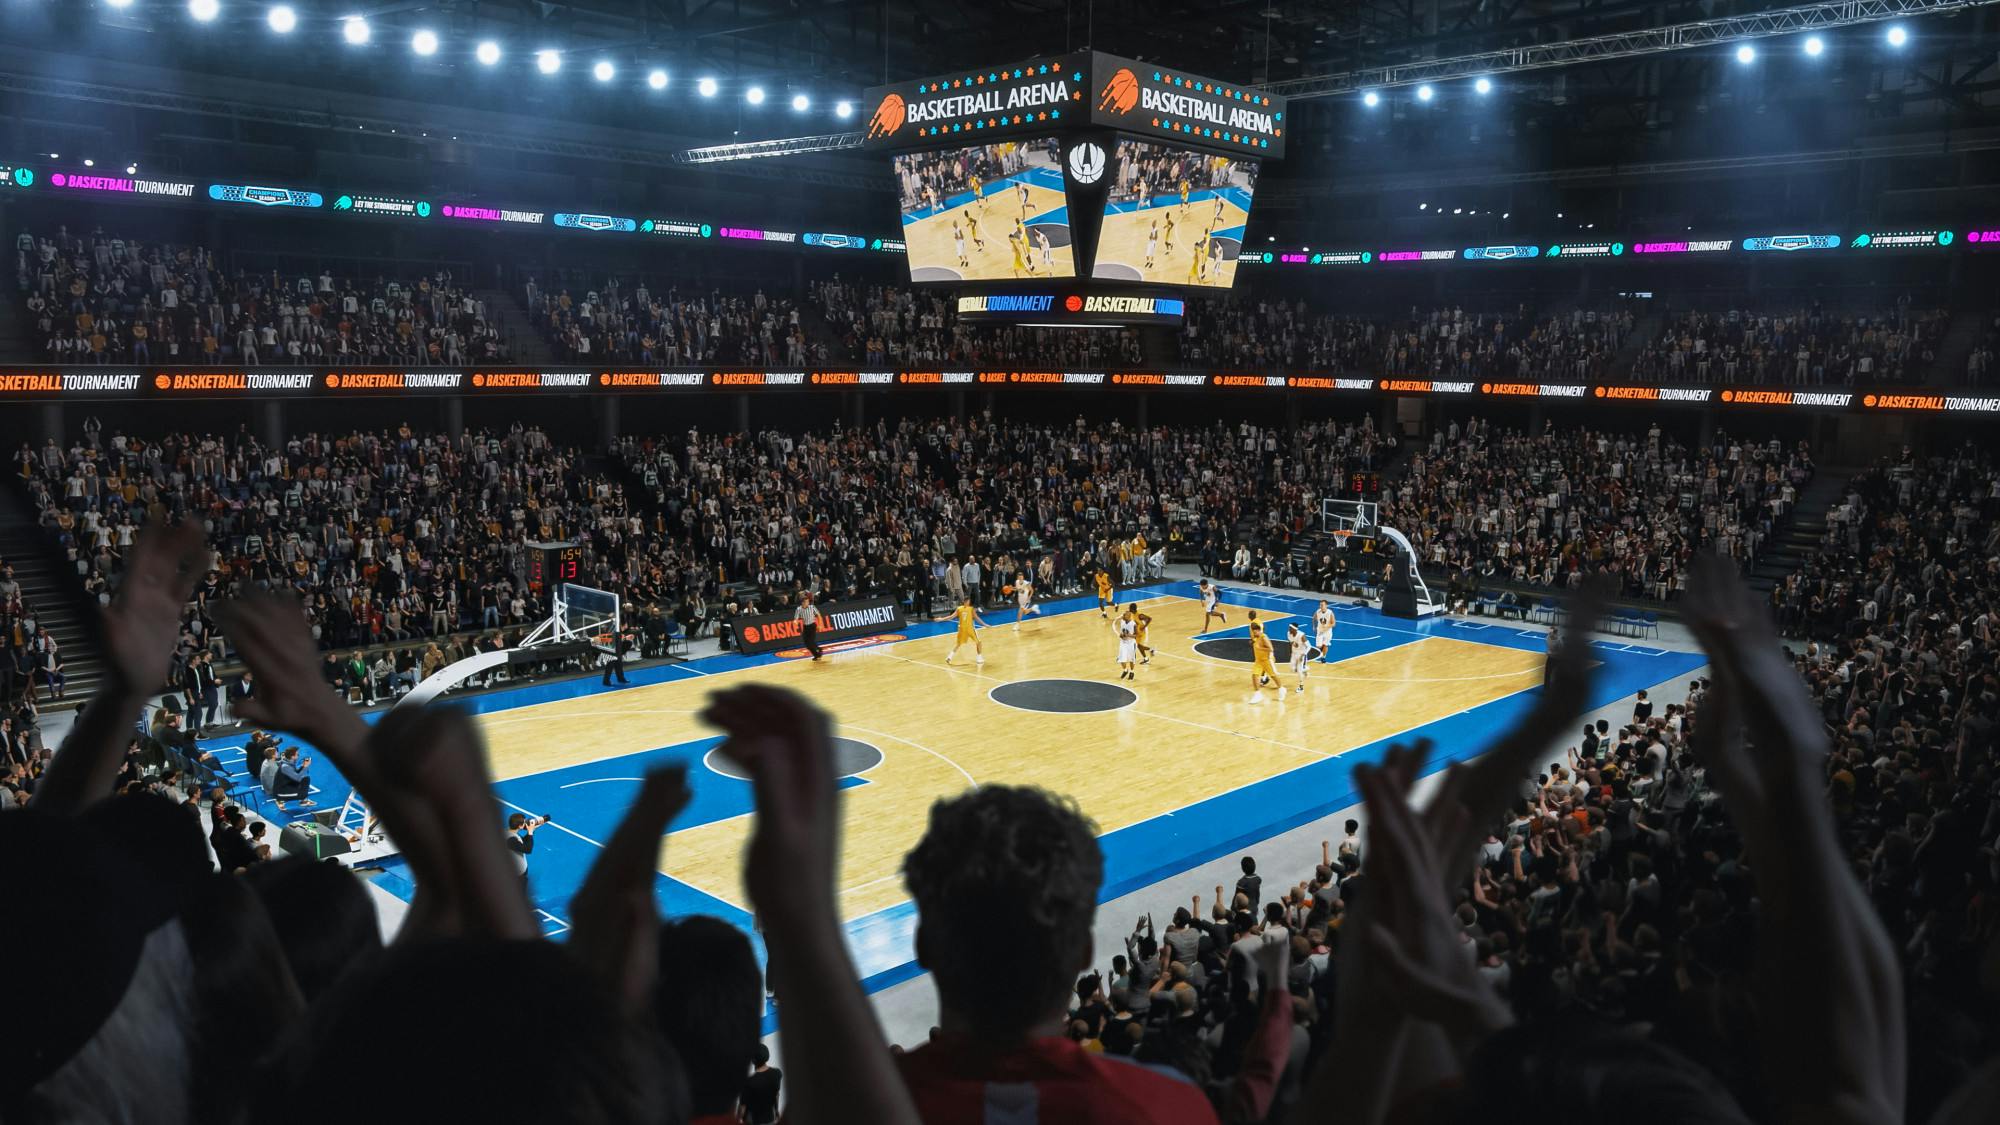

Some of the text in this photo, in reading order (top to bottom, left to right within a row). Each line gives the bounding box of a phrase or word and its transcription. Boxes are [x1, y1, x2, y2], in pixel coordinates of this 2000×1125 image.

[908, 80, 1069, 123] BASKETBALL ARENA
[1141, 87, 1274, 135] BASKETBALL ARENA
[561, 548, 582, 560] 1:54
[560, 561, 577, 578] 13
[436, 598, 444, 608] 7
